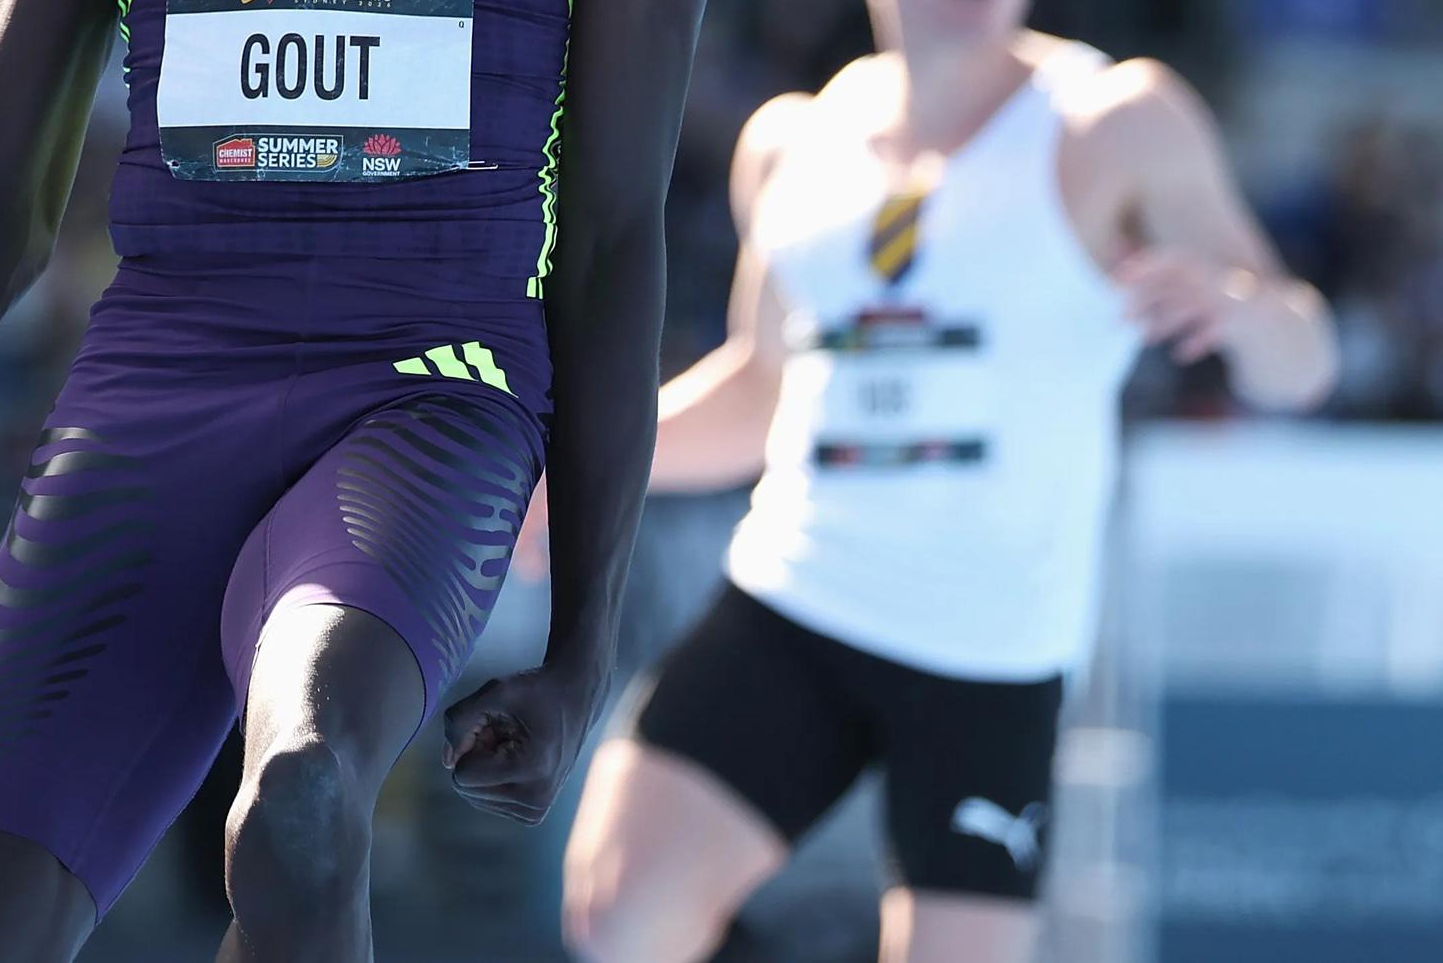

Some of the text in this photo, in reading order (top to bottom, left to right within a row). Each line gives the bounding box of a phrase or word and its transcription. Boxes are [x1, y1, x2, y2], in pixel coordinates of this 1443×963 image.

[241, 33, 380, 100] GOUT
[219, 148, 252, 158] CHEMIST
[258, 138, 338, 154] SUMMER
[258, 153, 316, 168] SERIES
[362, 157, 401, 171] NSW
